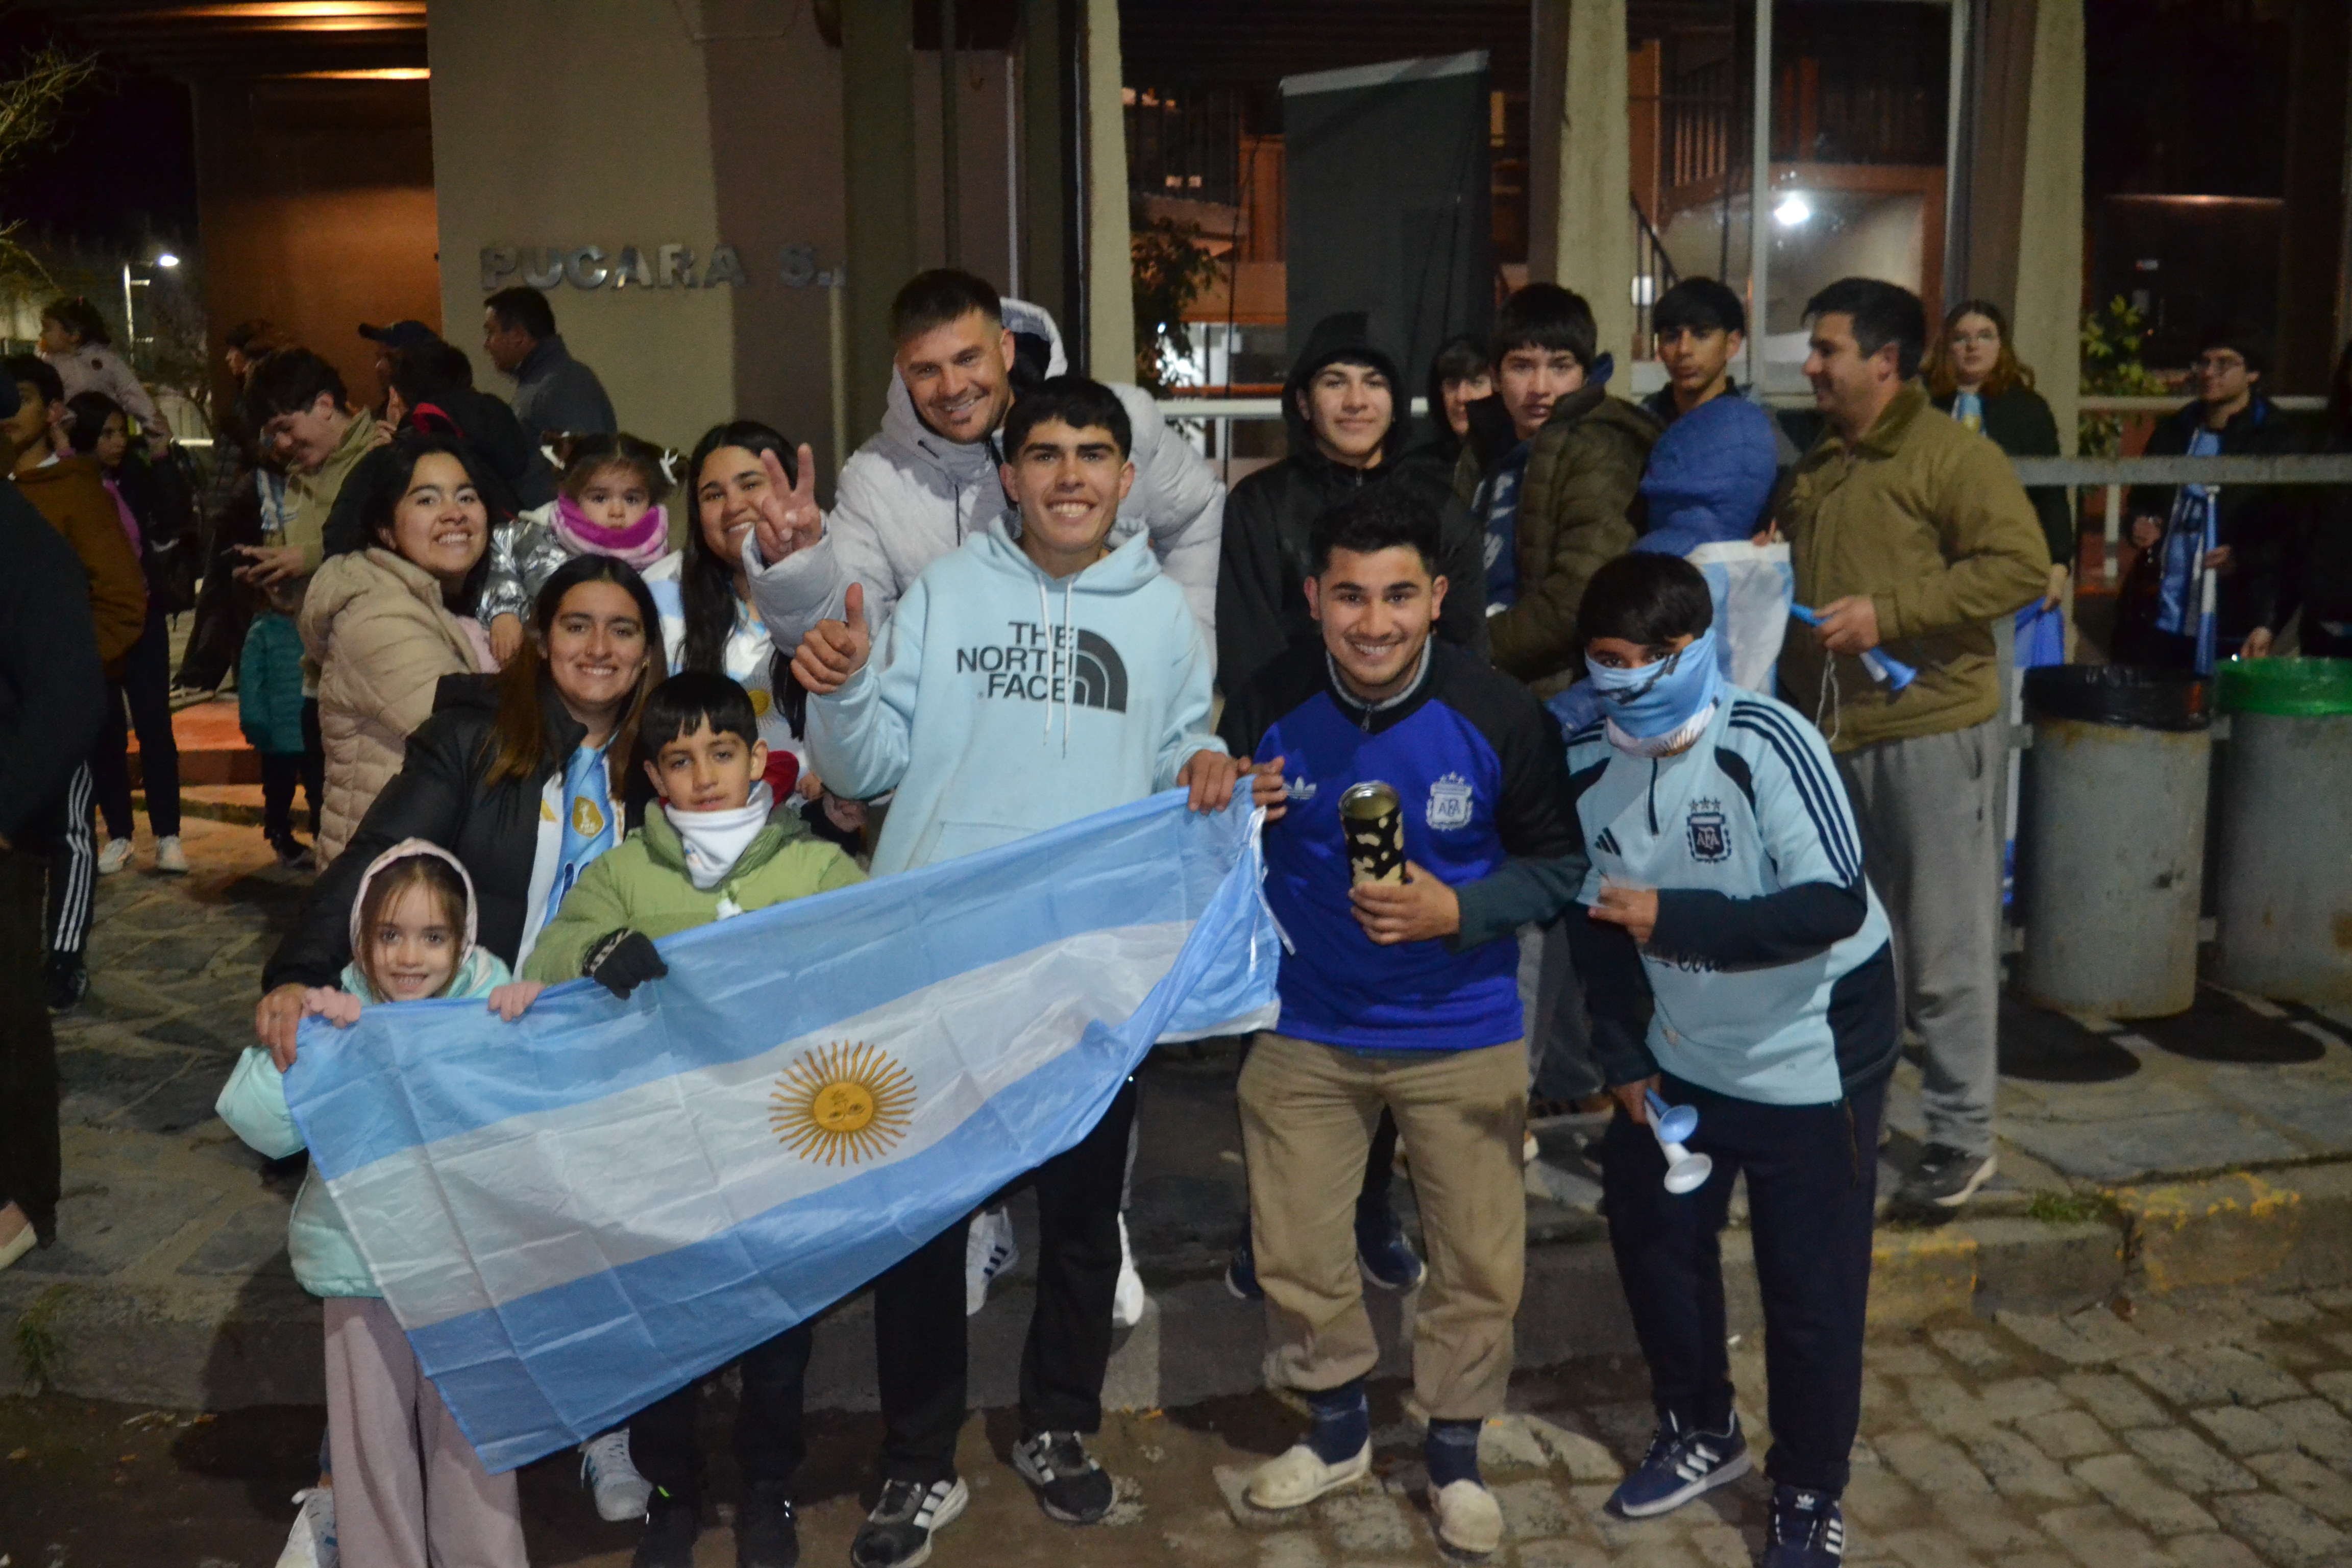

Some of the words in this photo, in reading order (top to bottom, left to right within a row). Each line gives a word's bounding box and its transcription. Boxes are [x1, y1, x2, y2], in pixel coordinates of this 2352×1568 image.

[480, 242, 747, 290] PUCARA
[1008, 621, 1074, 649] THE
[957, 646, 1072, 676] NORTH
[987, 673, 1072, 702] FACE
